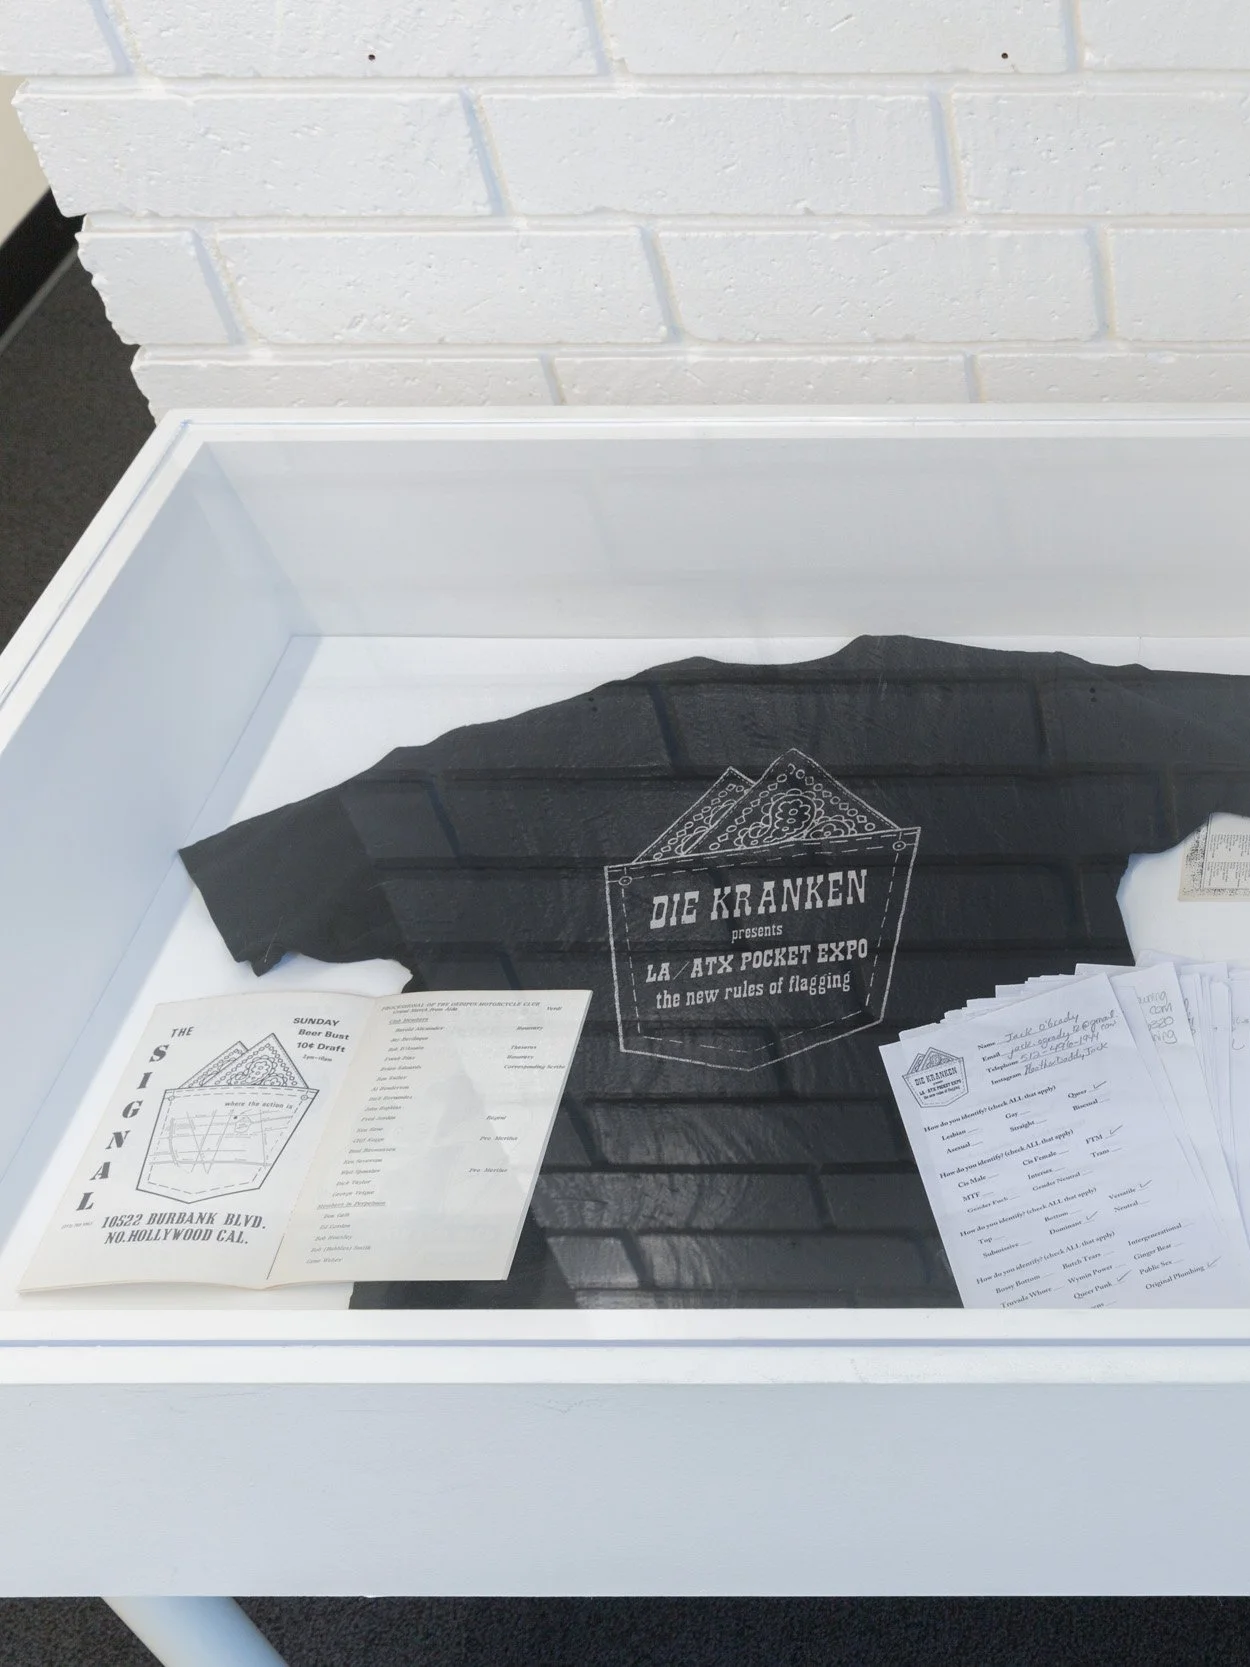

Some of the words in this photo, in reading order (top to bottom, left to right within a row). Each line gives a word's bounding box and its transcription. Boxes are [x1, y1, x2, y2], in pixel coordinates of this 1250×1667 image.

[650, 890, 700, 929] DIE
[710, 869, 868, 921] KRANKEN
[731, 925, 783, 943] presents
[740, 944, 812, 971] POCKET
[816, 938, 869, 964] EXPO
[656, 989, 681, 1010] the
[686, 986, 722, 1006] new
[724, 981, 764, 1001] rules
[769, 976, 784, 996] of
[788, 970, 852, 995] flagging
[293, 1017, 340, 1027] SUNDAY
[171, 1027, 193, 1038] THE
[298, 1029, 323, 1040] Beer
[325, 1030, 350, 1041] Bust
[296, 1042, 315, 1051] 10¢
[317, 1043, 346, 1053] Draft
[977, 1042, 996, 1051] Name
[982, 1051, 1001, 1062] Email
[986, 1060, 1019, 1074] Telephone
[991, 1072, 1022, 1085] Instagram
[262, 1101, 284, 1109] action
[285, 1102, 294, 1110] is
[924, 1122, 939, 1133] How
[940, 1119, 949, 1127] do
[949, 1116, 961, 1126] you
[961, 1107, 988, 1121] identify?
[988, 1100, 1008, 1113] (check
[1008, 1095, 1024, 1104] ALL
[1024, 1091, 1037, 1100] that
[1036, 1085, 1056, 1097] apply)
[941, 1129, 967, 1141] Lesbian
[1005, 1111, 1019, 1120] Gay
[1067, 1089, 1088, 1099] Queer
[1009, 1120, 1035, 1132] Straight
[1072, 1098, 1099, 1111] Bisexual
[1085, 1133, 1103, 1144] FTM
[1022, 1158, 1034, 1166] Cis
[1034, 1151, 1057, 1162] Female
[1090, 1148, 1110, 1158] Trans
[1108, 1187, 1136, 1200] Versatile
[101, 1212, 144, 1229] 10522
[146, 1211, 218, 1226] BURBANK
[223, 1213, 267, 1229] BLVD.
[1049, 1220, 1082, 1235] Dominant
[216, 1229, 249, 1245] CAL.
[1127, 1222, 1183, 1246] Intergenerational
[1073, 1288, 1095, 1300] Queer
[1095, 1281, 1113, 1292] Punk
[1145, 1276, 1173, 1290] Original
[1173, 1265, 1206, 1280] Plumbing
